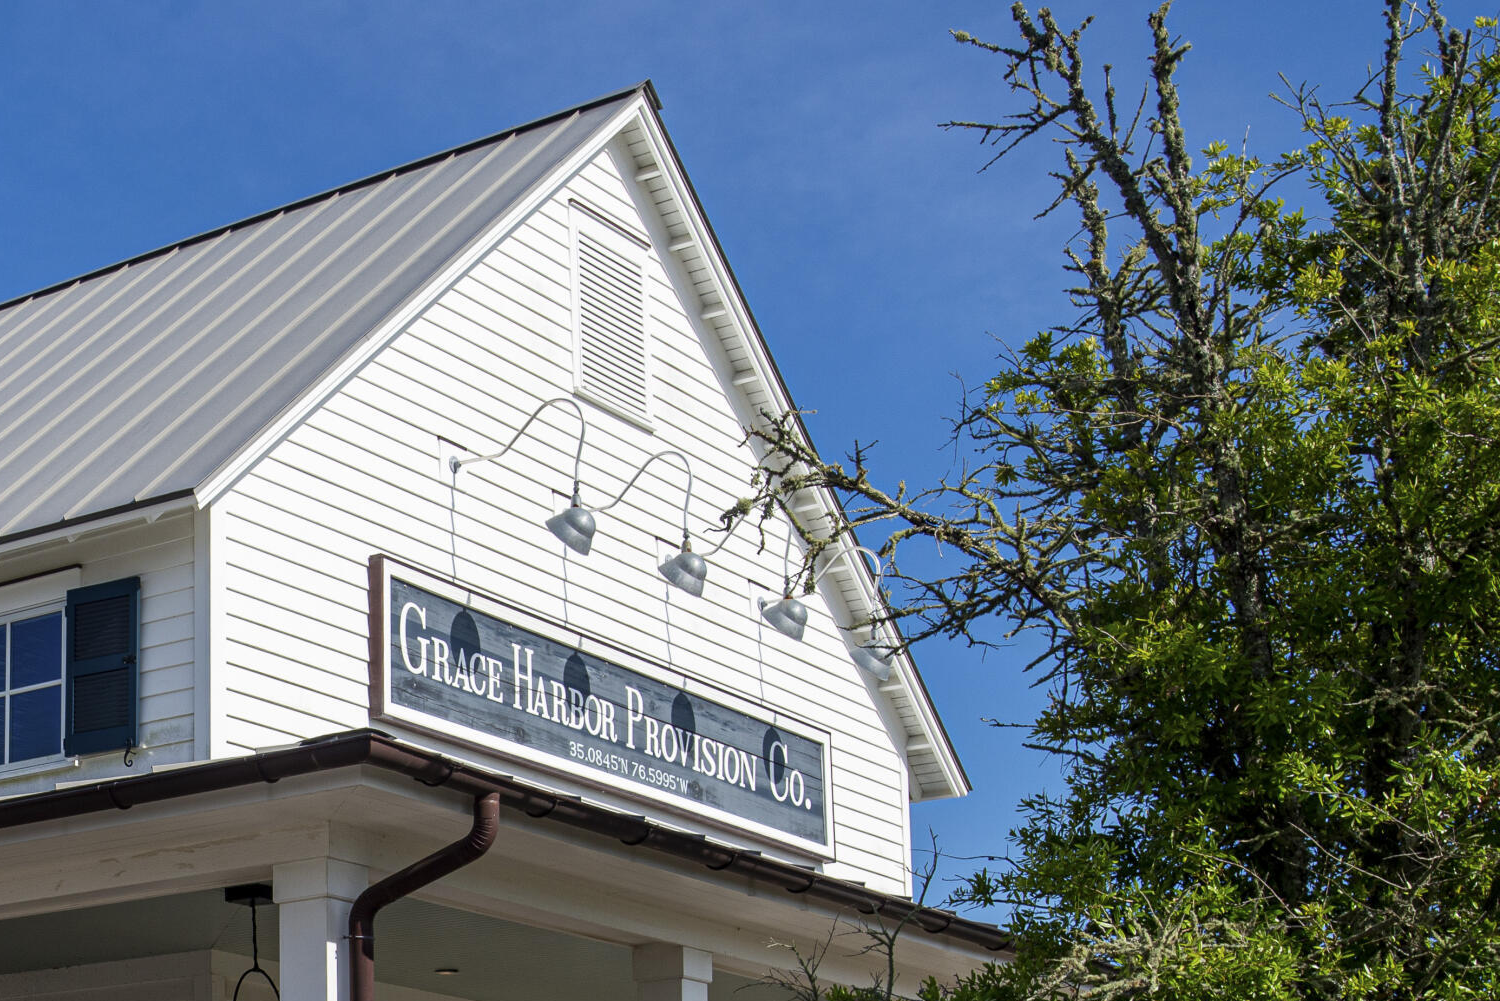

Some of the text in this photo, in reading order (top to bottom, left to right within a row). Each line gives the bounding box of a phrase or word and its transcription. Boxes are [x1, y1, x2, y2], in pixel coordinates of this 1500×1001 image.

[399, 603, 503, 703] GRACE
[512, 643, 618, 742] HARBOR
[625, 686, 757, 792] PROVISION
